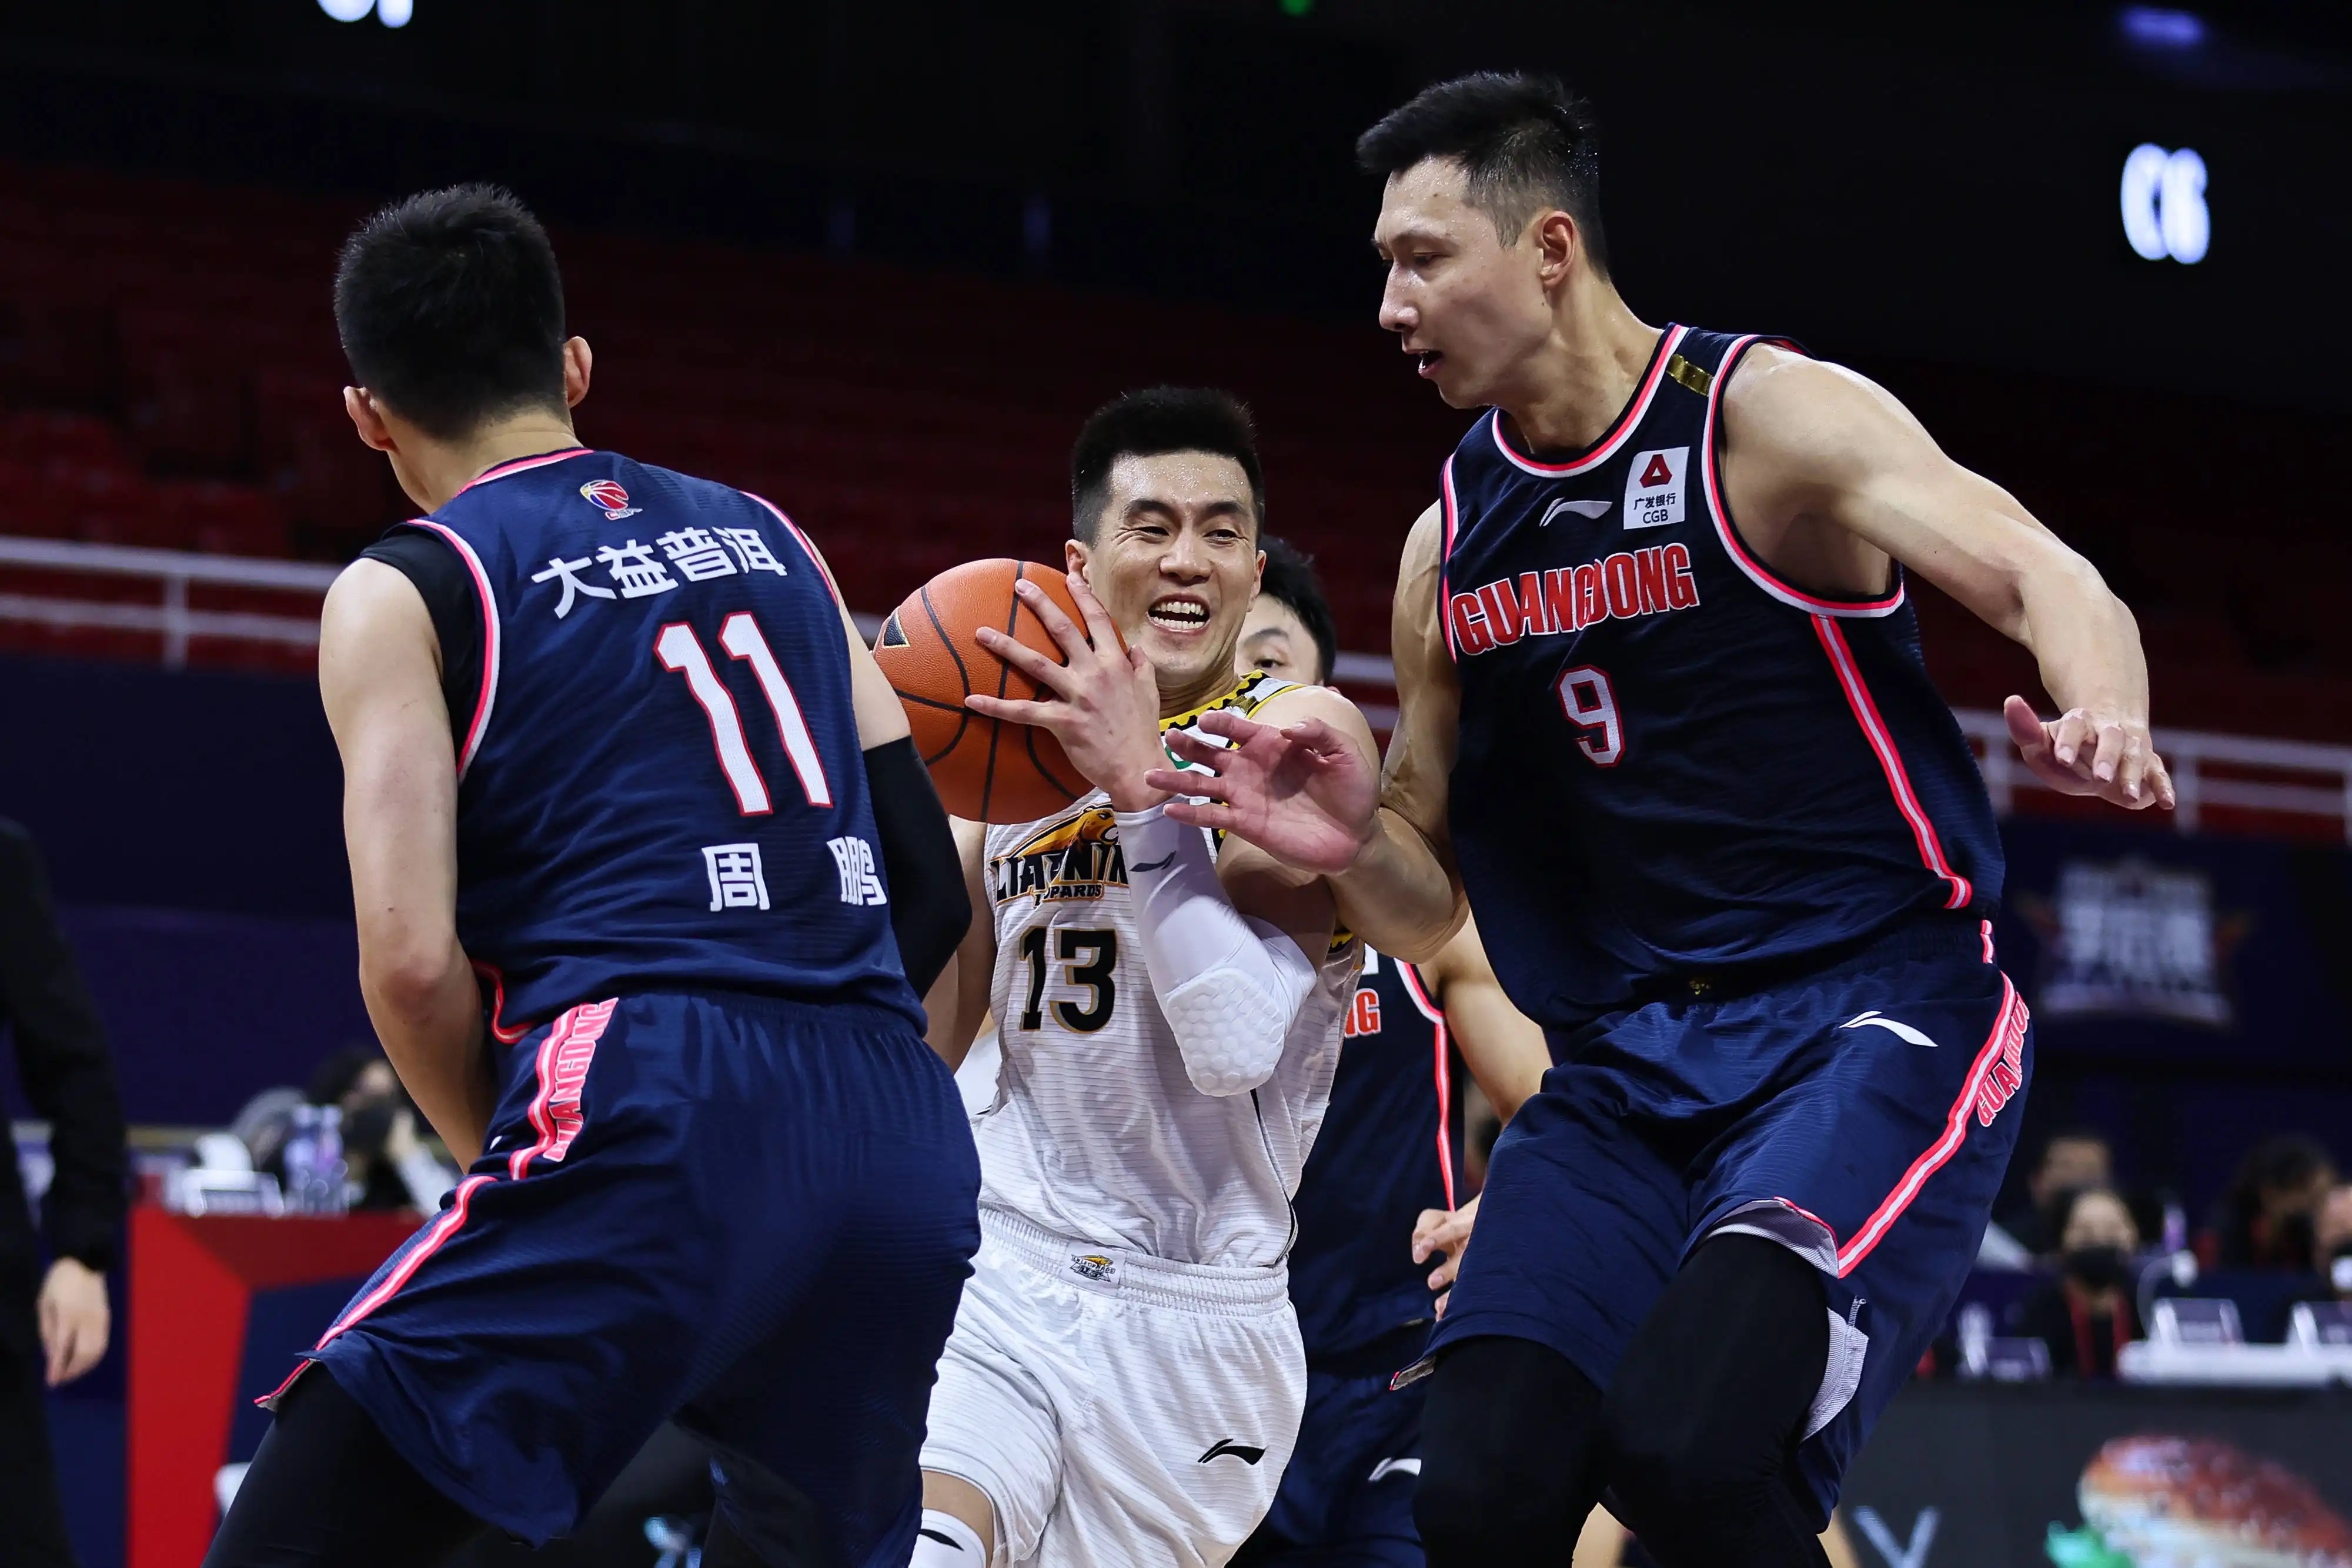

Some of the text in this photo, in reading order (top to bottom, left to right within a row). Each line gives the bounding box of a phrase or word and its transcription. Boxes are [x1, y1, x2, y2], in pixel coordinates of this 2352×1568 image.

[1634, 493, 1676, 510] 广发银行
[1643, 509, 1668, 523] CGB
[532, 526, 787, 619] 大益普洱
[1451, 543, 1700, 656] GUANGDONG
[653, 611, 833, 815] 11
[1555, 664, 1626, 768] 9
[1019, 927, 1118, 1033] 13
